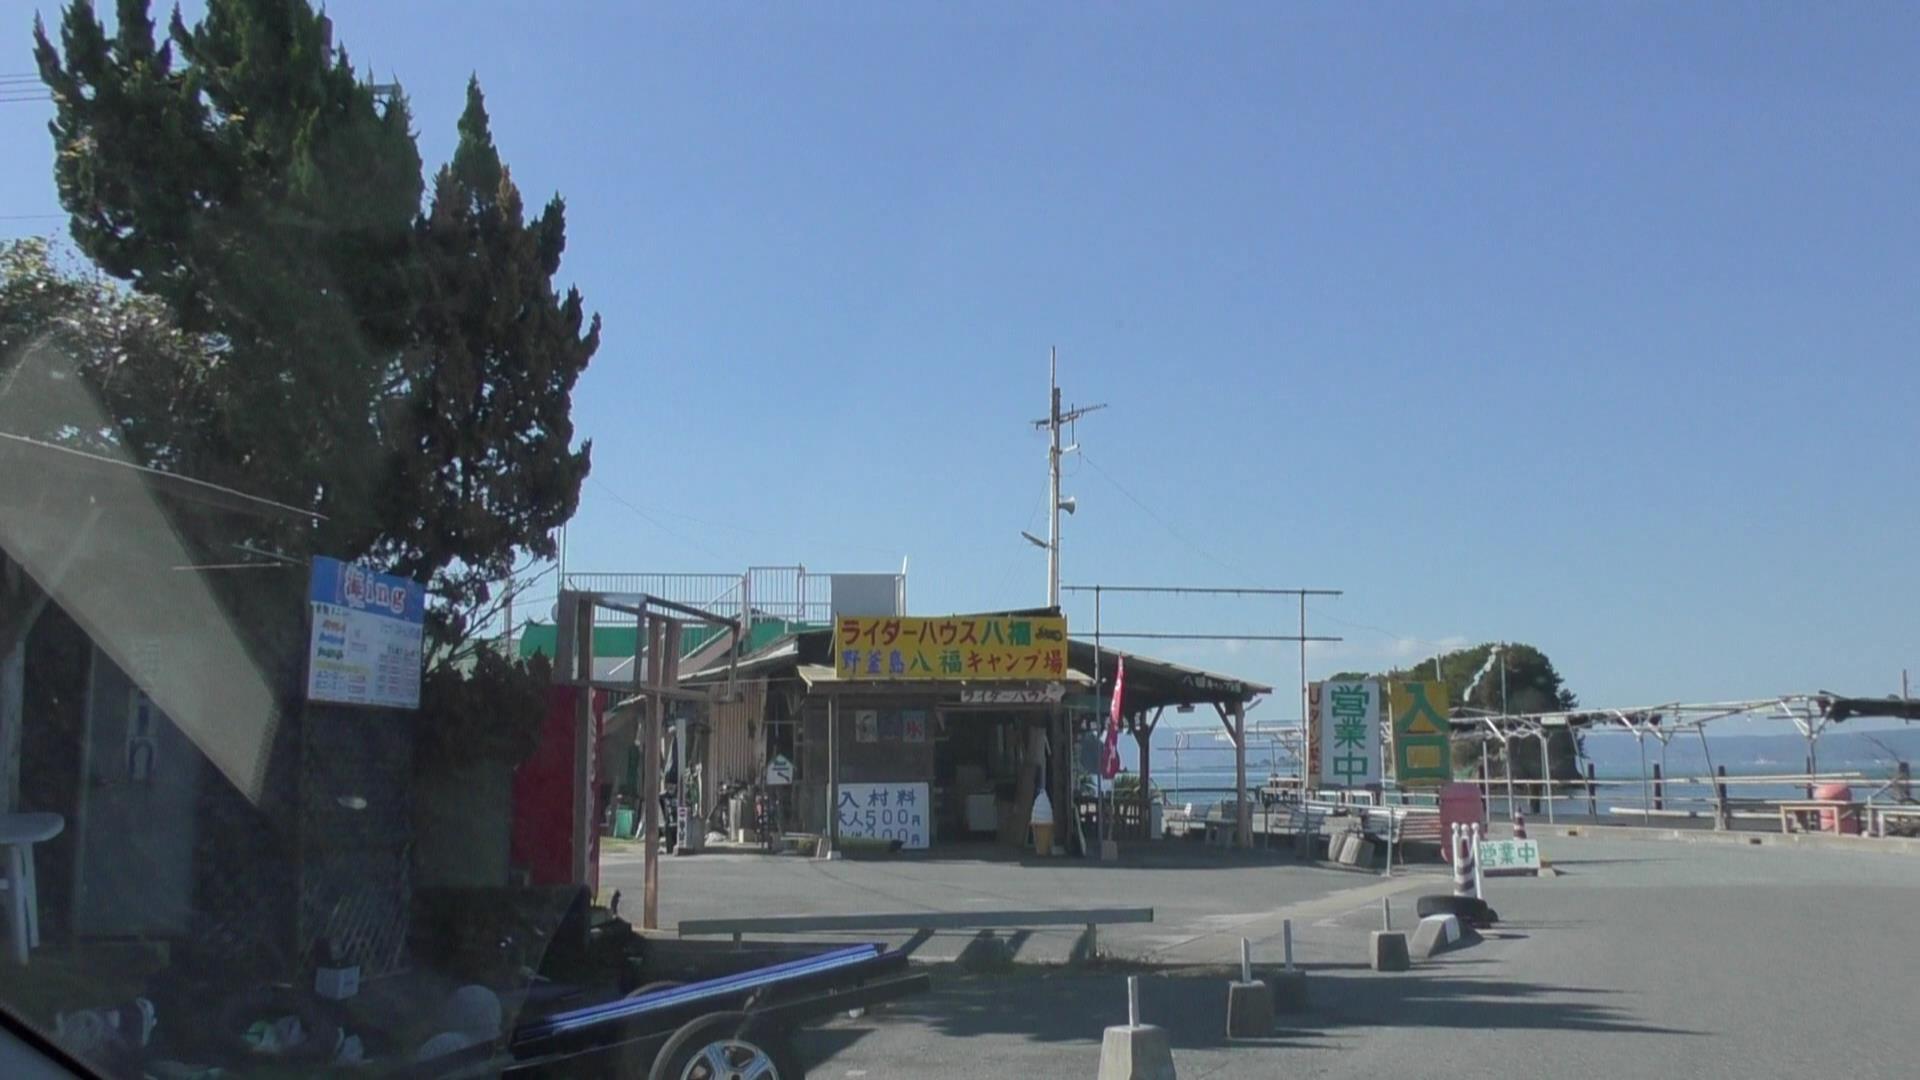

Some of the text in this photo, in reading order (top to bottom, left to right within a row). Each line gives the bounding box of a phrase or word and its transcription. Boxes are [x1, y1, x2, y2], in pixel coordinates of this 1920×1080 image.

[841, 620, 1031, 646] ライダーハウス八福
[1330, 683, 1370, 786] 営業中
[1396, 682, 1451, 780] 入口
[839, 787, 916, 809] 入村料
[1480, 841, 1536, 867] 営業中
